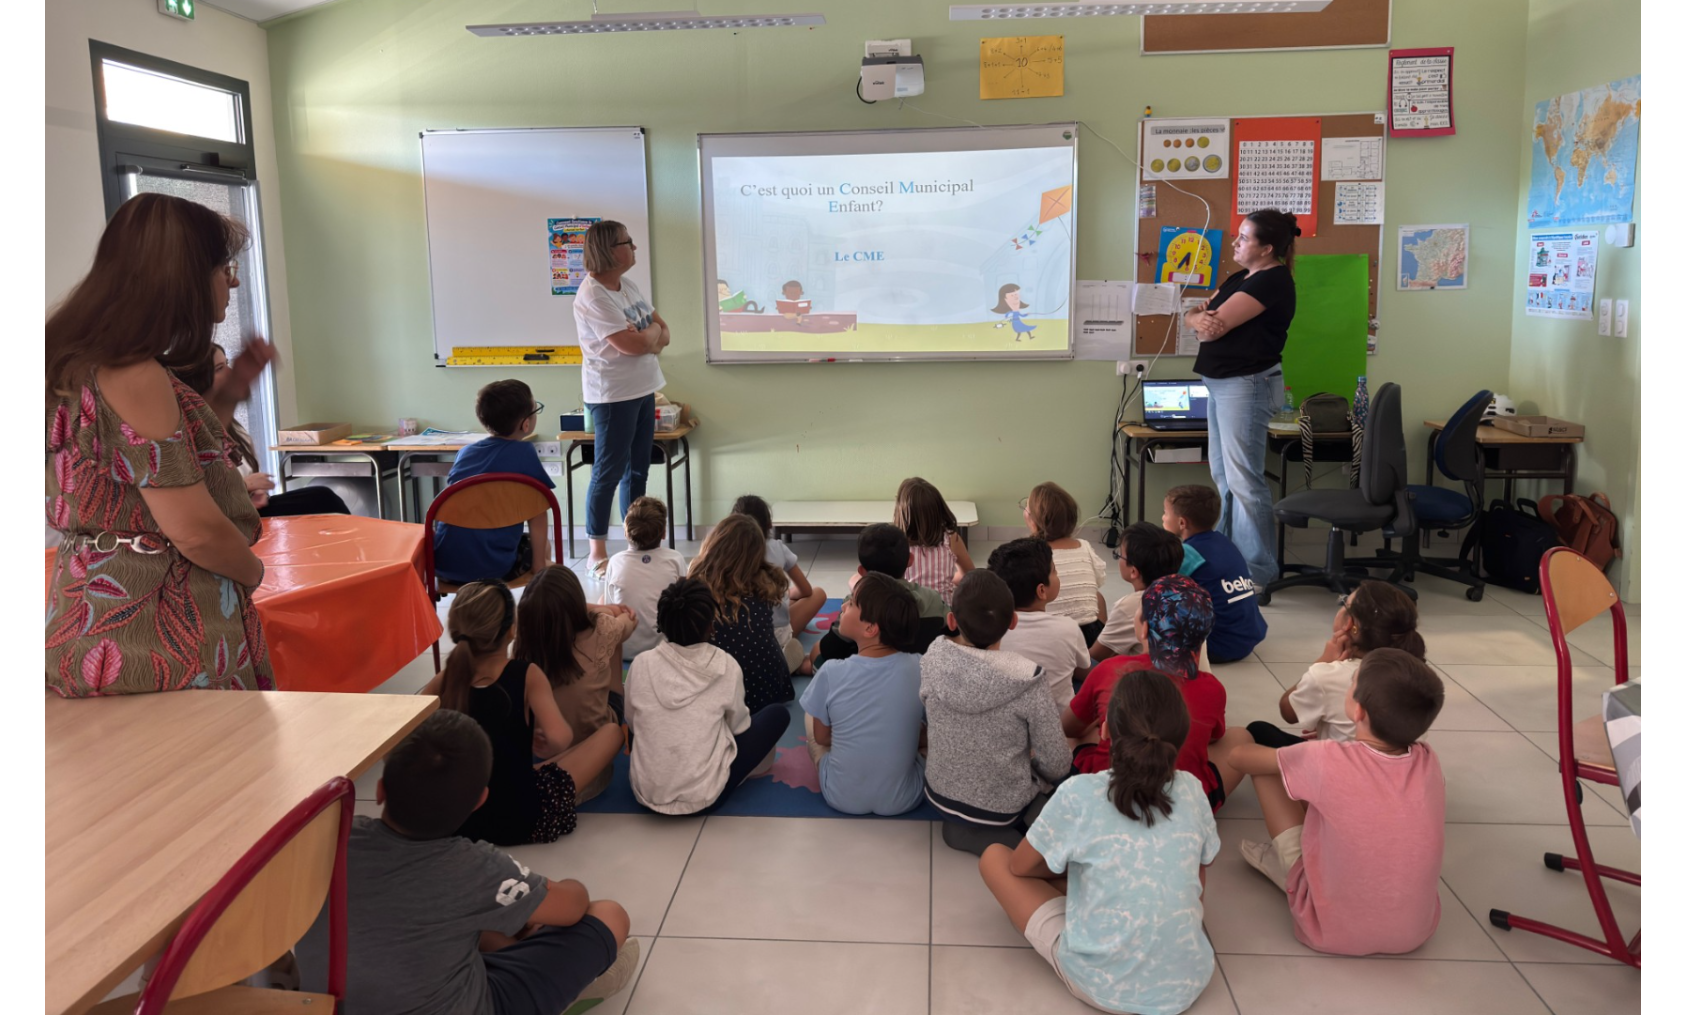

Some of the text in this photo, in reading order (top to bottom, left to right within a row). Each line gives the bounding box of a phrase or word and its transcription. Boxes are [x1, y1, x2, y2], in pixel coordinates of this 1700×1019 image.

[1015, 57, 1028, 68] 10
[782, 183, 812, 199] quoi
[818, 186, 834, 196] un
[840, 181, 894, 195] Conseil
[899, 179, 974, 196] Municipal
[829, 200, 883, 213] Enfant?
[835, 251, 884, 262] Le CME
